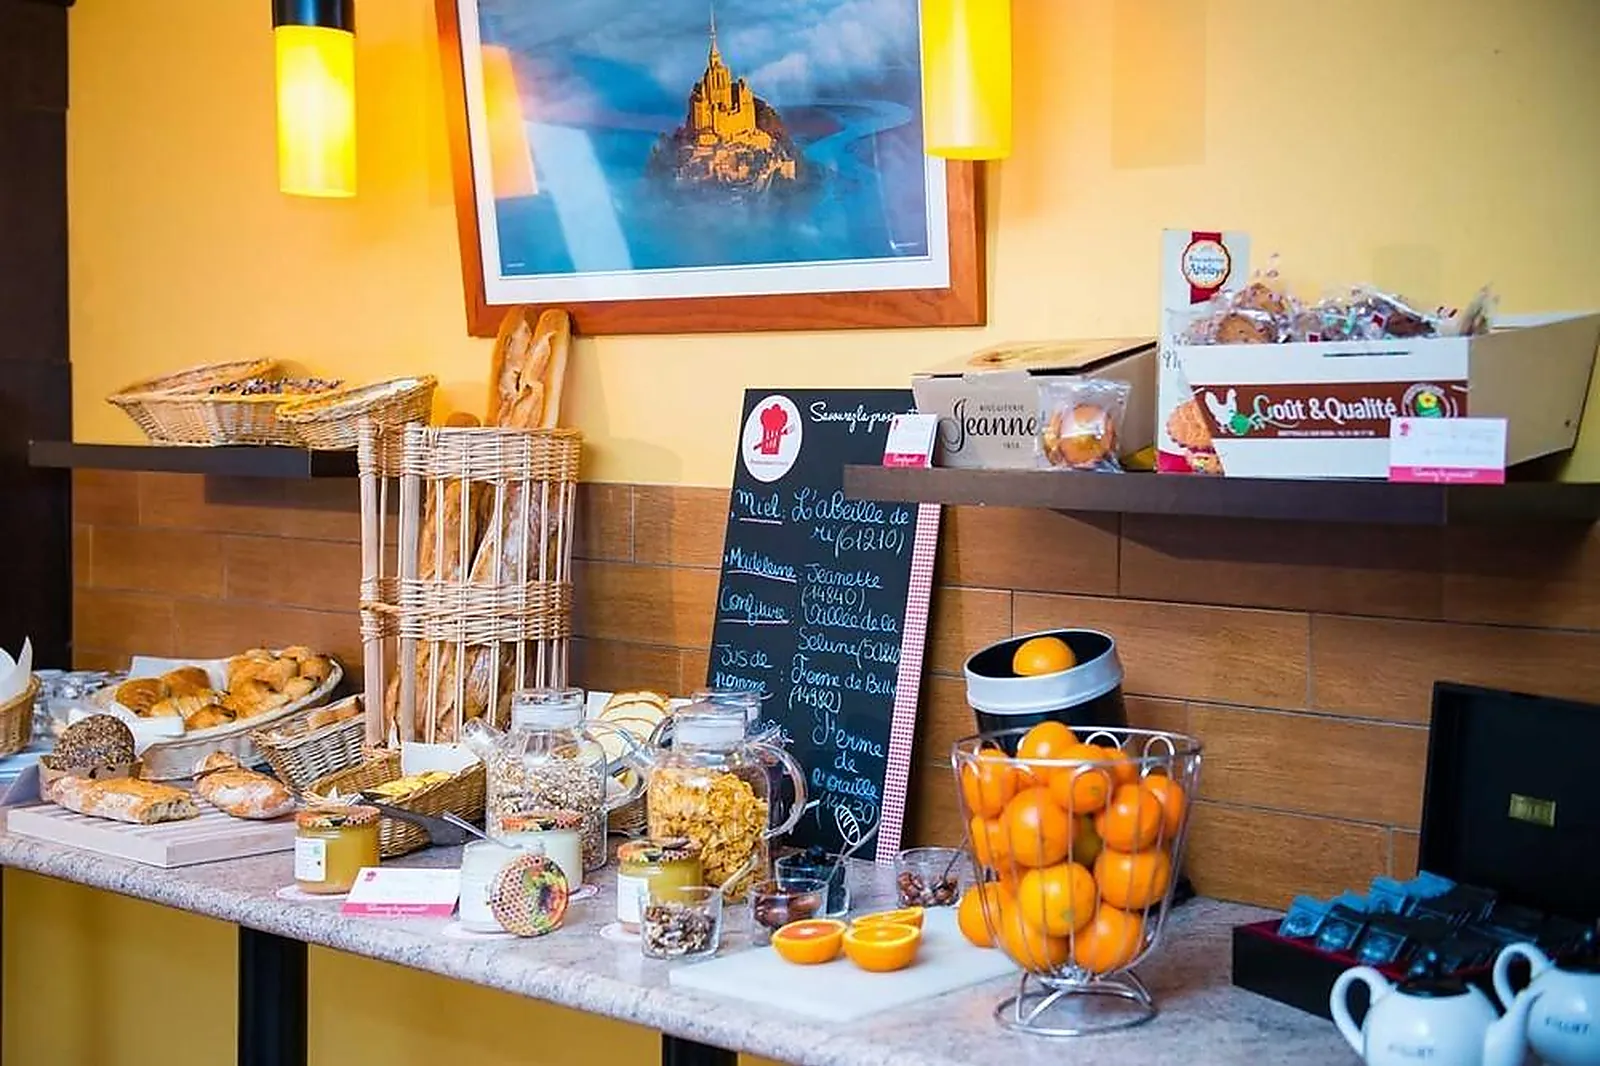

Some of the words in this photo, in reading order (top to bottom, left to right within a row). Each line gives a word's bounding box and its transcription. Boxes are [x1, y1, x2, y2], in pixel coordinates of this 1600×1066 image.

[1324, 397, 1398, 425] Qualité
[939, 398, 1038, 454] Jeanne
[889, 506, 909, 525] de
[833, 750, 859, 774] de
